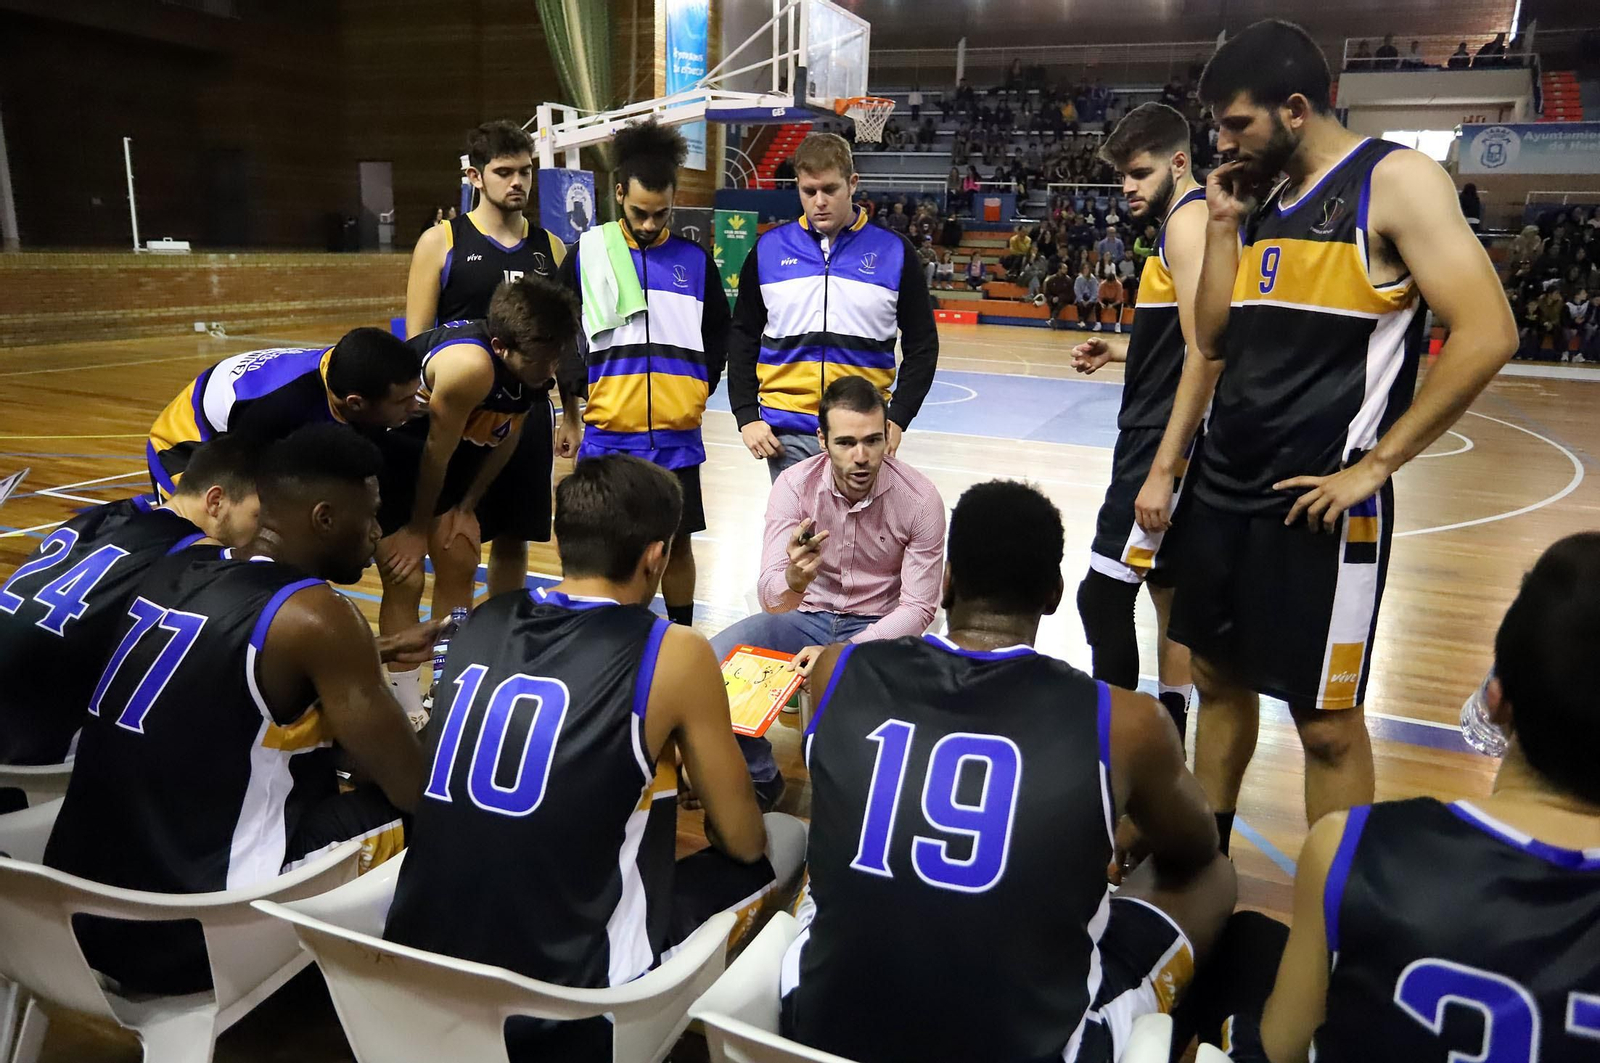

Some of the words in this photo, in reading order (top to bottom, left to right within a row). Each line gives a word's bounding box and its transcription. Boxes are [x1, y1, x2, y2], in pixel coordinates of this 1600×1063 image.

[1523, 130, 1600, 143] Ayuntamie
[781, 257, 799, 267] vive
[1259, 246, 1281, 294] 9
[0, 527, 131, 637] 24
[88, 595, 209, 734] 77
[1330, 670, 1358, 683] vive
[424, 663, 570, 817] 10
[849, 718, 1022, 893] 19
